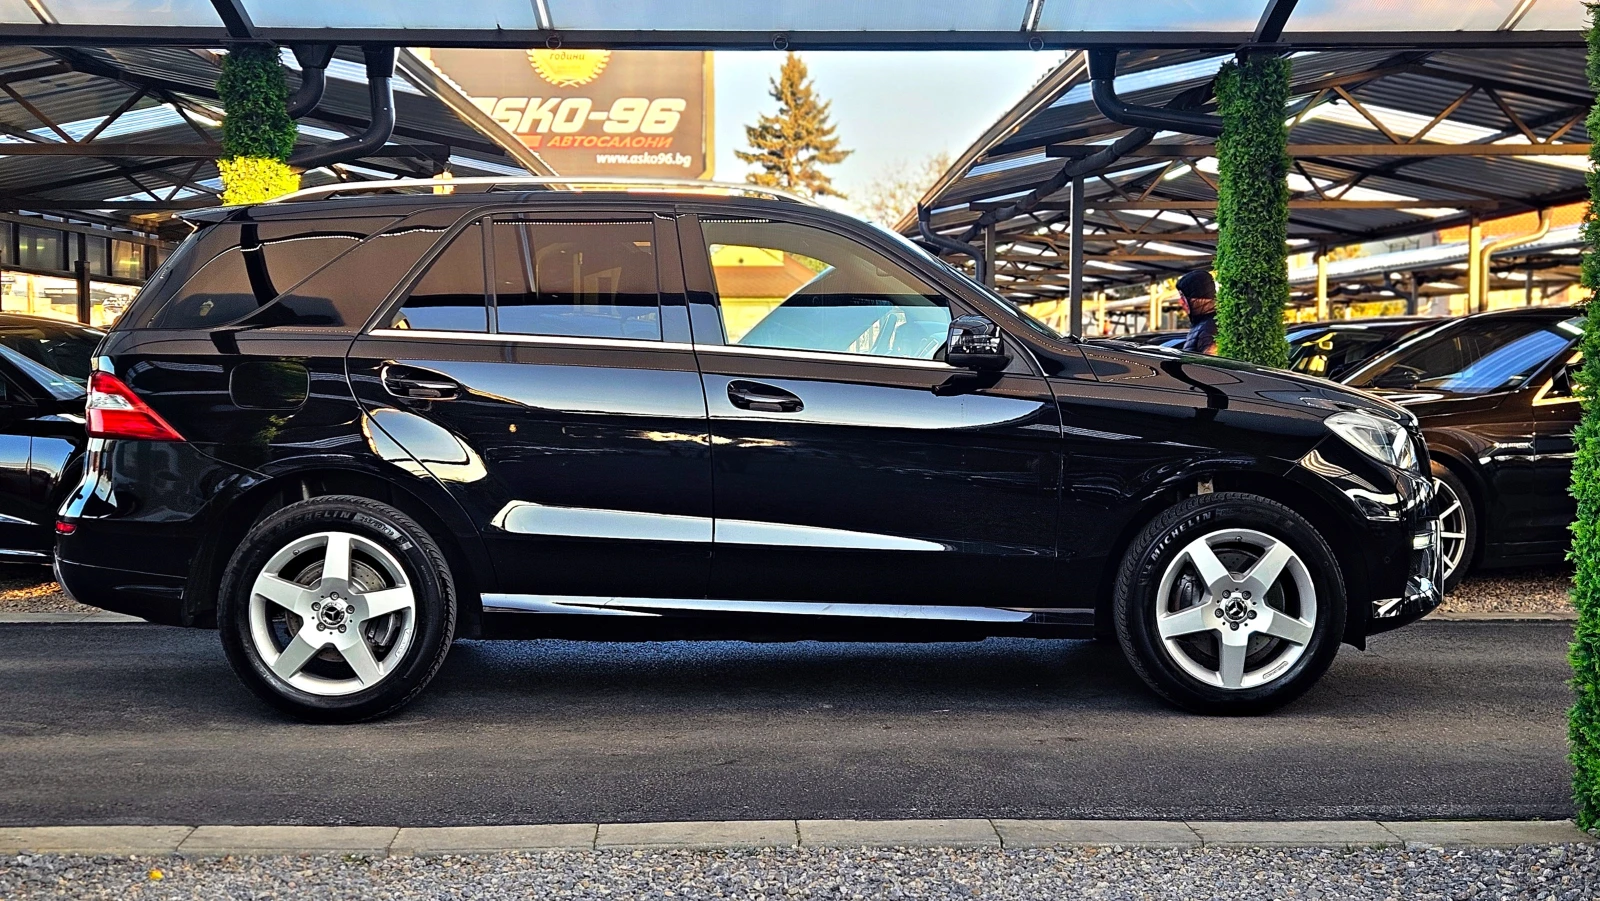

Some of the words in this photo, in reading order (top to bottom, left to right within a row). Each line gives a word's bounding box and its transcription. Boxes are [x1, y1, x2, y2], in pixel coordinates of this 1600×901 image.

[549, 51, 586, 61] години
[546, 135, 674, 148] АВТОСАЛОНИ
[596, 152, 692, 168] www.asko96.bg
[1150, 511, 1212, 561] MICHELIN
